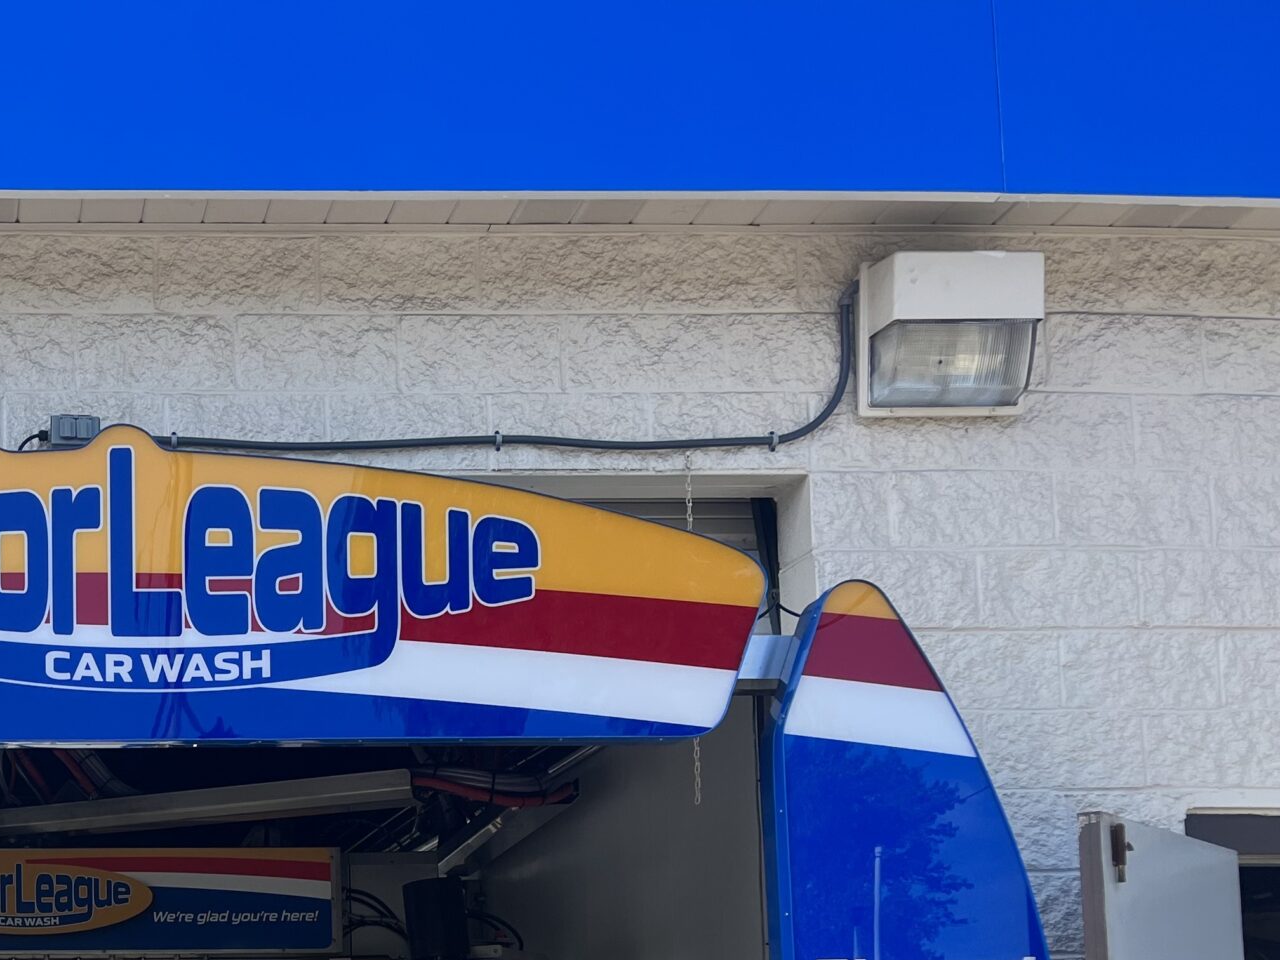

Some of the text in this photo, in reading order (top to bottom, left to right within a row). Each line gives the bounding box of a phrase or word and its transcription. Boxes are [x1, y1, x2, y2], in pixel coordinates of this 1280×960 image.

[45, 649, 271, 683] CAR WASH
[24, 916, 60, 927] WASH
[153, 909, 320, 925] We're glad you're here!
